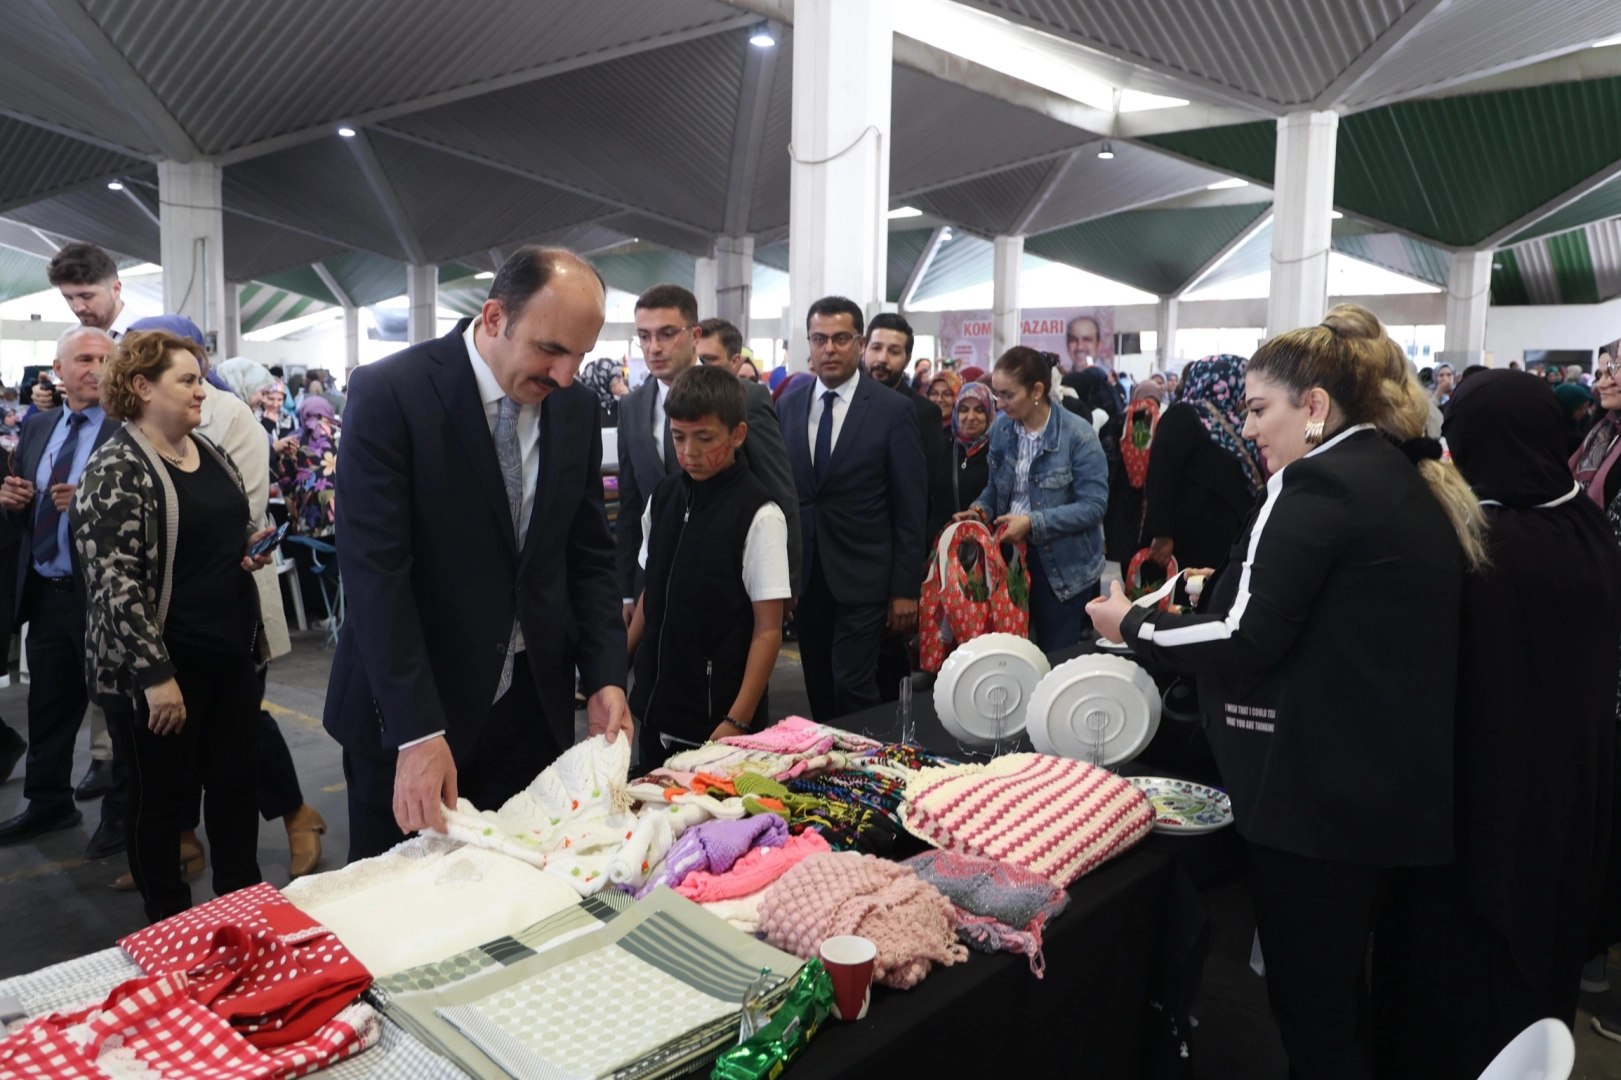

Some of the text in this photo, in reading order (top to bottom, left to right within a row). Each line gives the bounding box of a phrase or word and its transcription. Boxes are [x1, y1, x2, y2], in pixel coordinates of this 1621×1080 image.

[964, 319, 1064, 336] KOM AZARI
[1238, 705, 1249, 715] THAT
[1252, 707, 1267, 718] COULD
[1236, 719, 1246, 729] YOU
[1246, 720, 1255, 730] ARE
